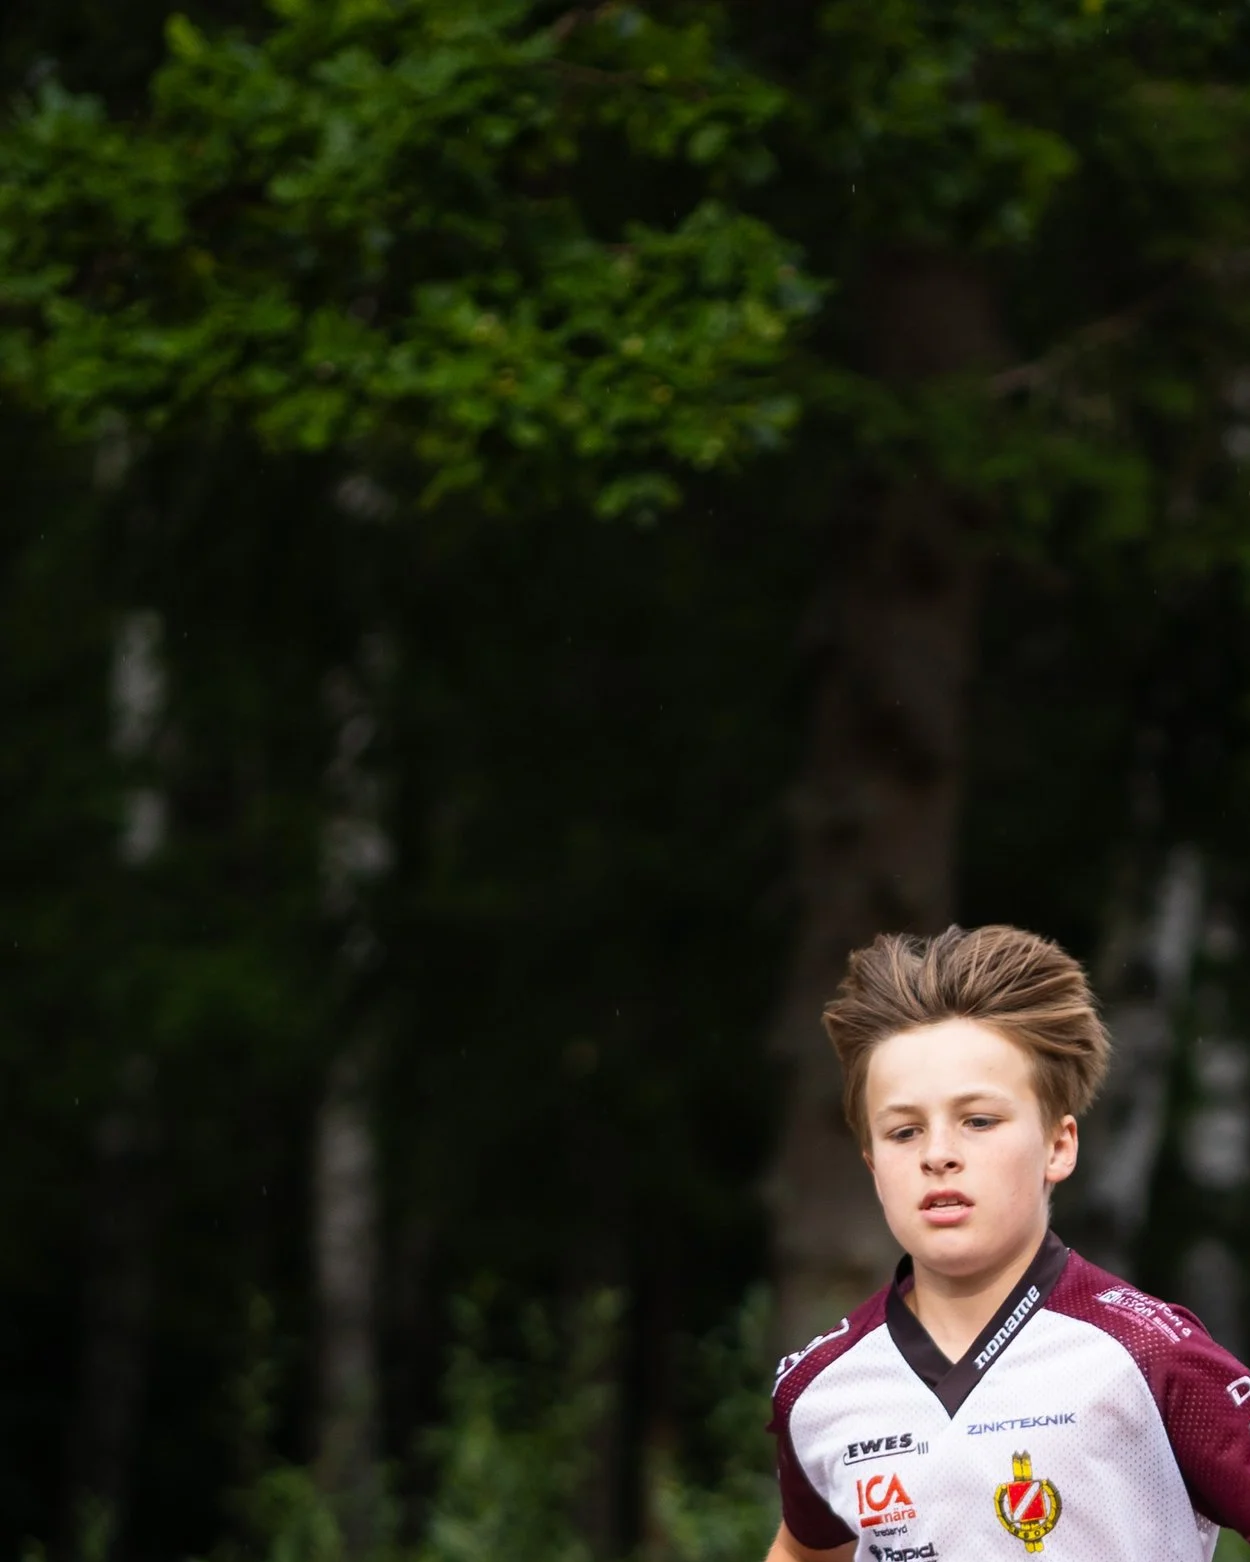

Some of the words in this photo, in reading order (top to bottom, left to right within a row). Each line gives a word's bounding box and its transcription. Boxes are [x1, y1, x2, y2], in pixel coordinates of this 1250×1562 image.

[973, 1285, 1041, 1370] noname
[967, 1412, 1076, 1435] ZINKTEKNIK
[847, 1433, 913, 1459] EWES
[856, 1473, 913, 1515] ICA
